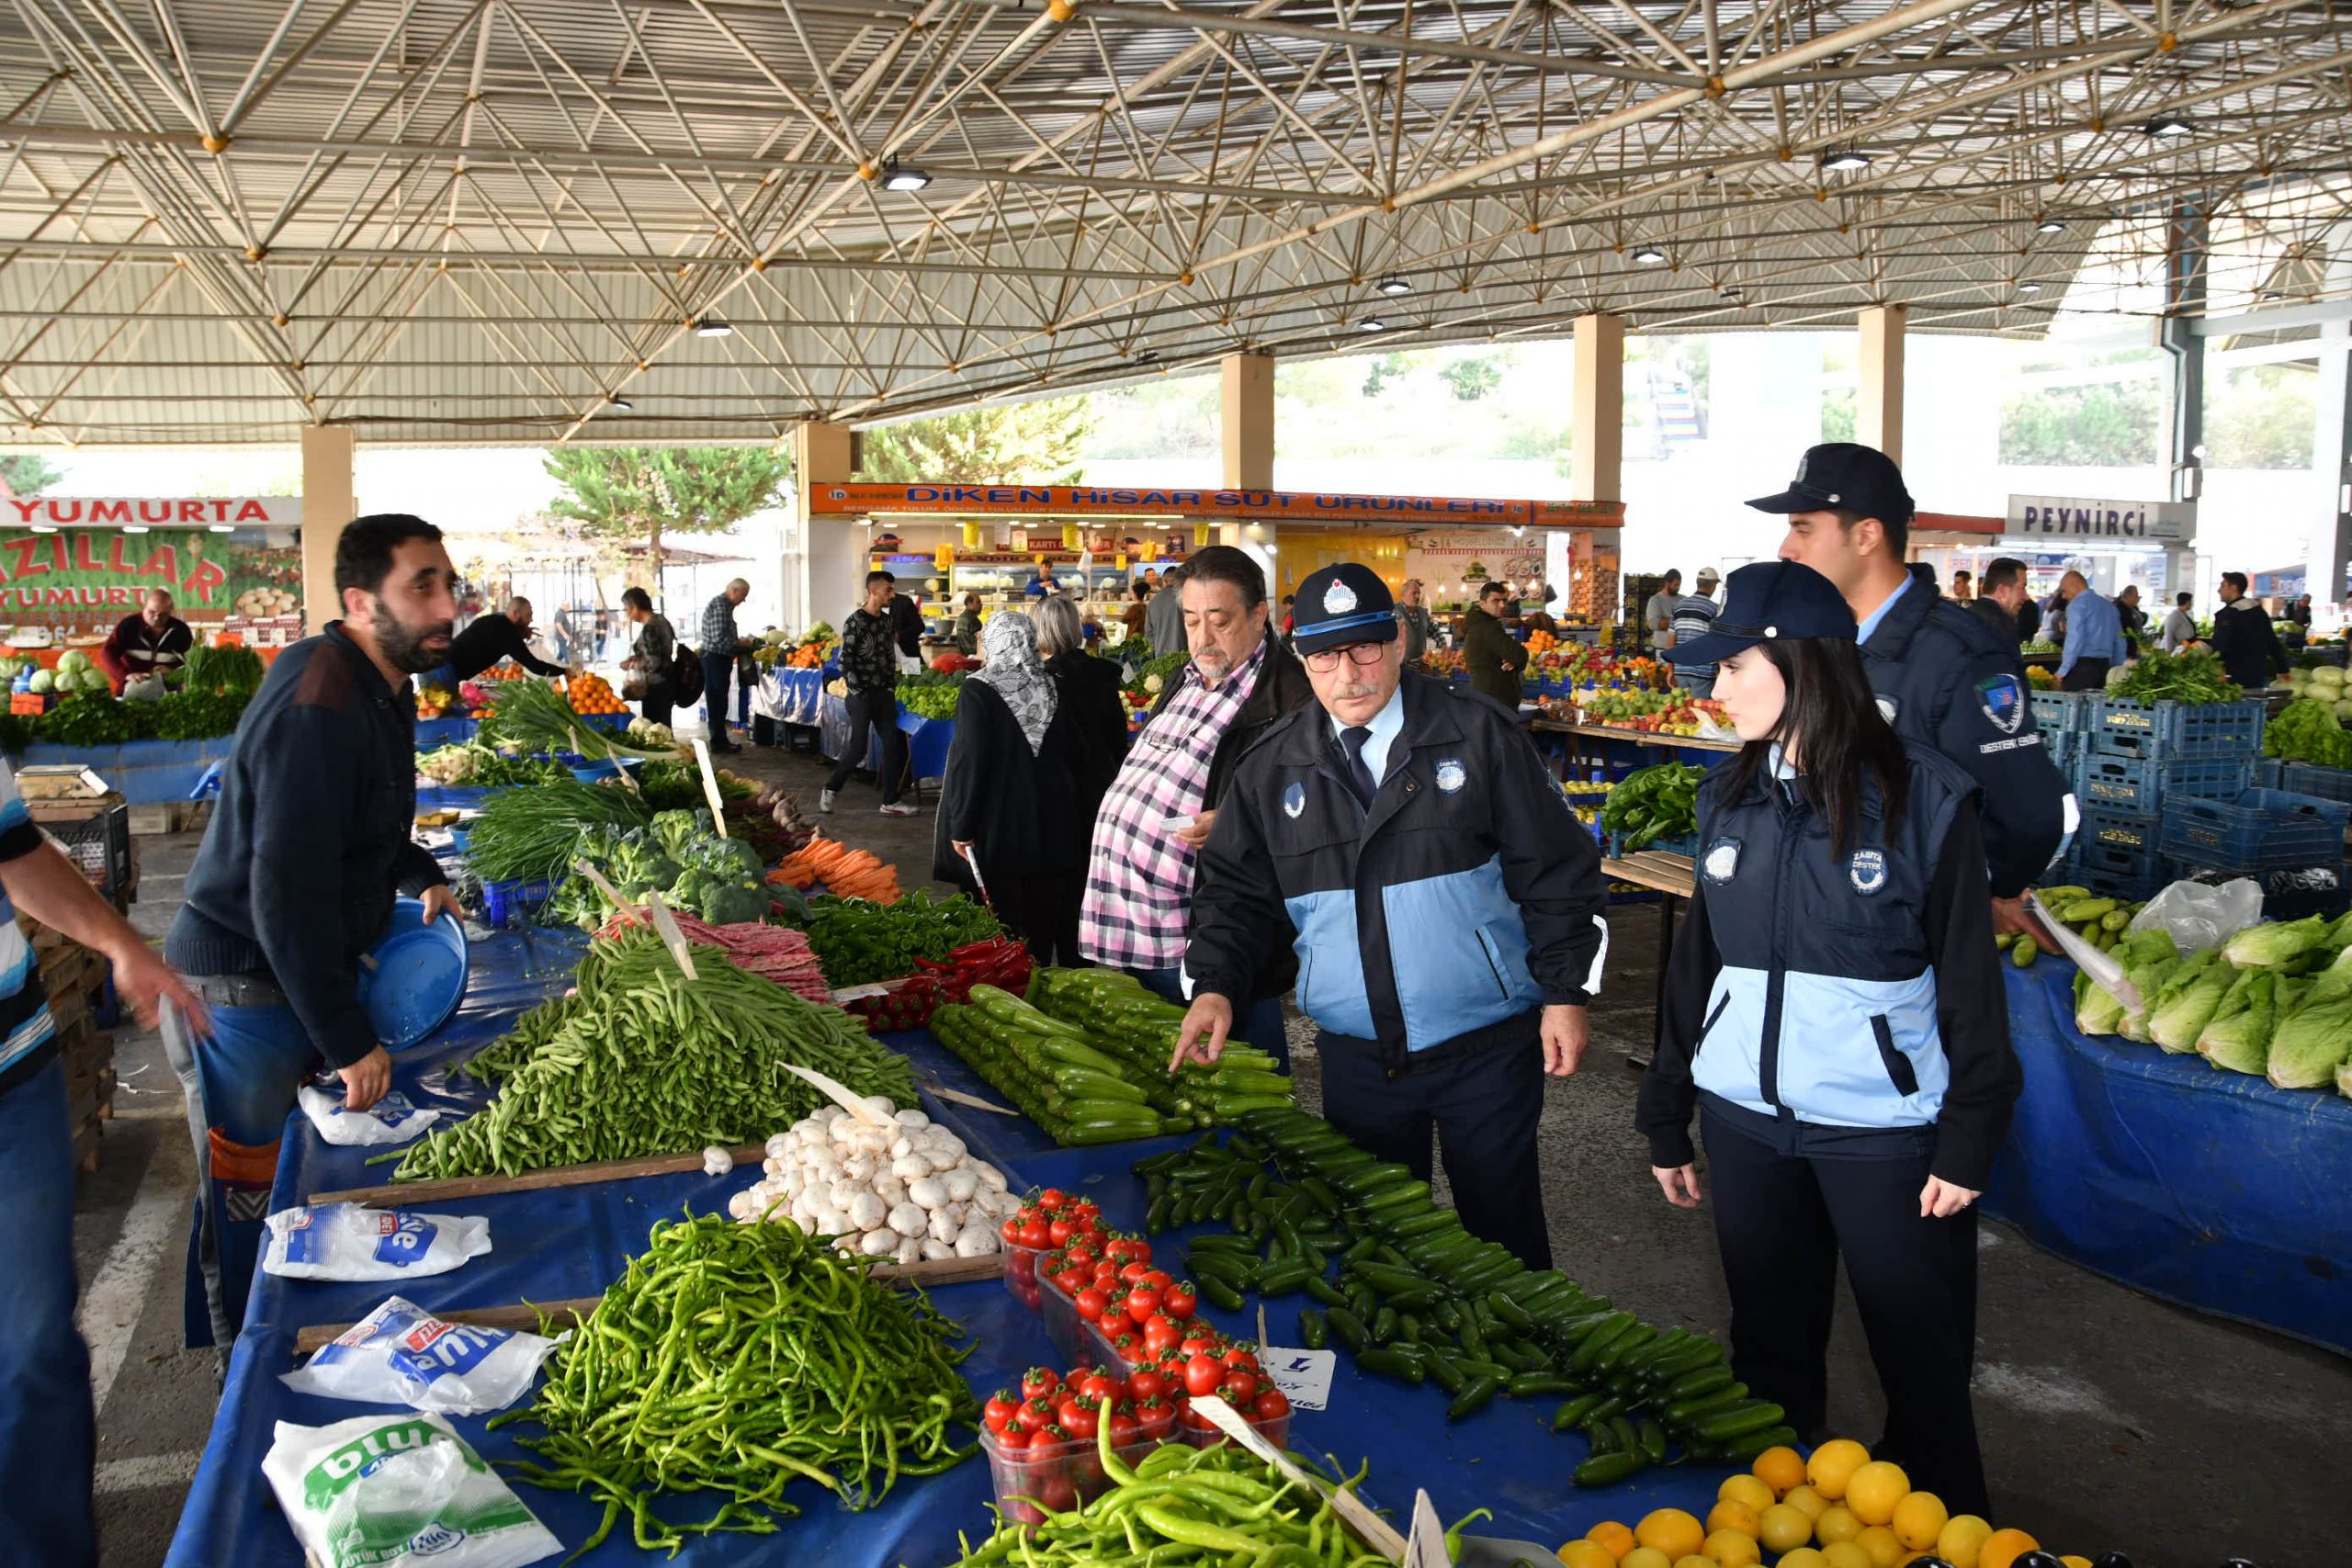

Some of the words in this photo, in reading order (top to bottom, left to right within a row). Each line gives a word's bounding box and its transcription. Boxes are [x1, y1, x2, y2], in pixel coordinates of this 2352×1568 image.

[1214, 491, 1298, 508] SÜT
[8, 500, 269, 523] YUMURTA
[2024, 502, 2146, 536] PEYNİRCİ
[0, 586, 169, 607] YUMURT
